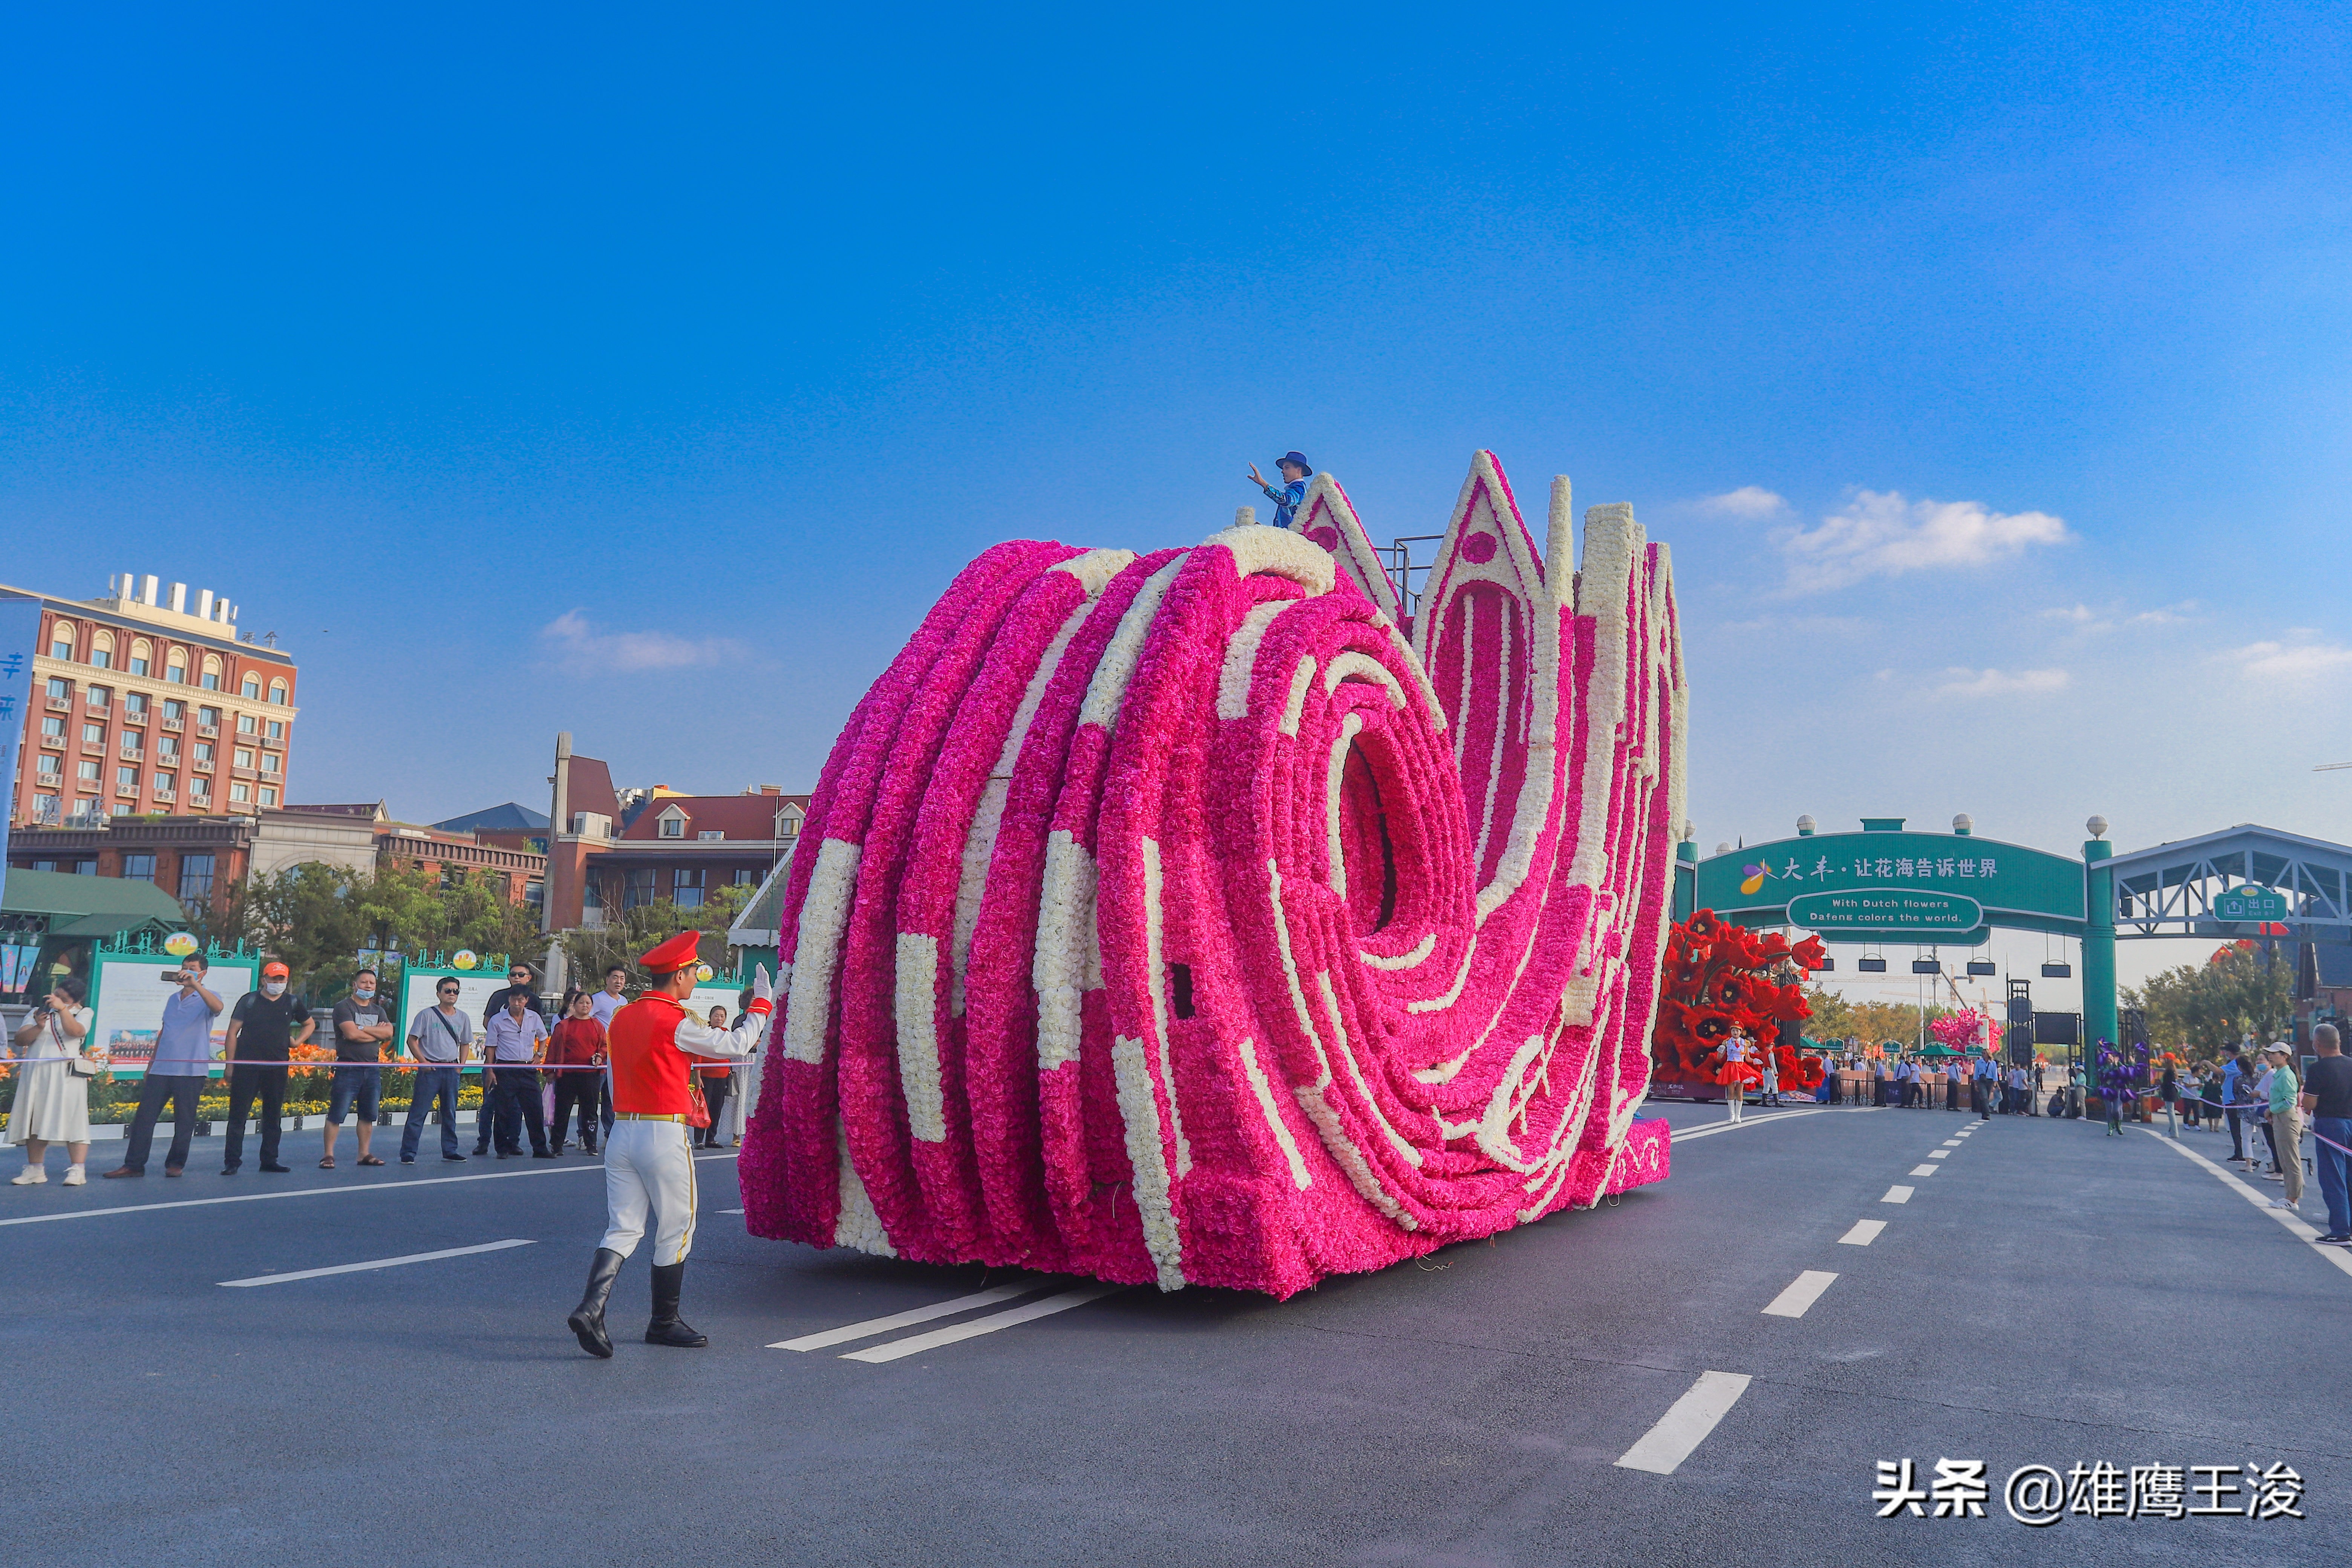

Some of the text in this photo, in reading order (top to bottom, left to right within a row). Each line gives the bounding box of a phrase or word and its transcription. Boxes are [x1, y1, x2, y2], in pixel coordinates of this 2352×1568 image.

[1782, 855, 1997, 882] 大丰·让花海告诉世界
[1832, 899, 1949, 908] With Dutch flowers
[2248, 898, 2274, 909] 出口
[1810, 912, 1853, 921] Dafeng
[1858, 913, 1894, 922] colors
